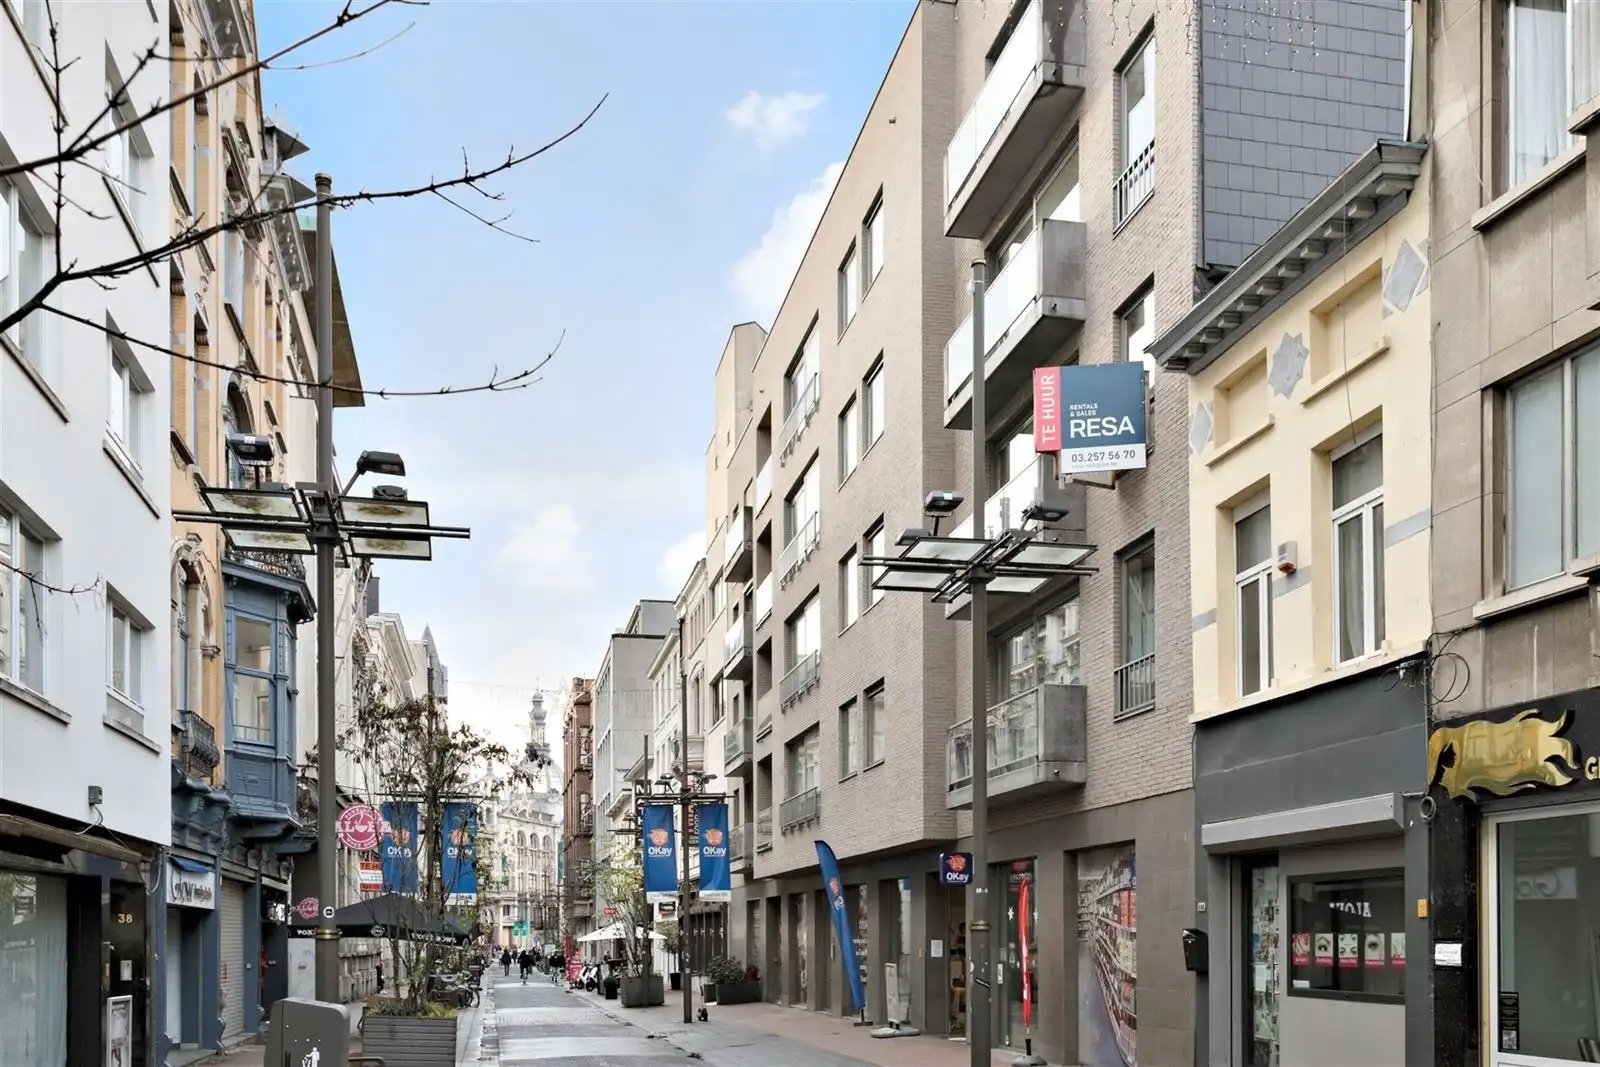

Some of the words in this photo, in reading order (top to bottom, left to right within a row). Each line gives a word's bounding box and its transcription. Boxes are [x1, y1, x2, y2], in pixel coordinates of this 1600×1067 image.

[1041, 374, 1055, 419] HUUR
[1069, 403, 1098, 411] RENTALS
[1076, 409, 1097, 417] SALES
[1069, 415, 1135, 439] RESA
[1042, 425, 1056, 444] TE
[1071, 451, 1106, 463] 03.257
[1108, 451, 1121, 461] 56
[1123, 449, 1136, 459] 70
[1585, 756, 1600, 781] G
[648, 846, 672, 857] OKay
[703, 846, 727, 857] OKay
[946, 872, 969, 884] OKay
[117, 913, 134, 924] 38
